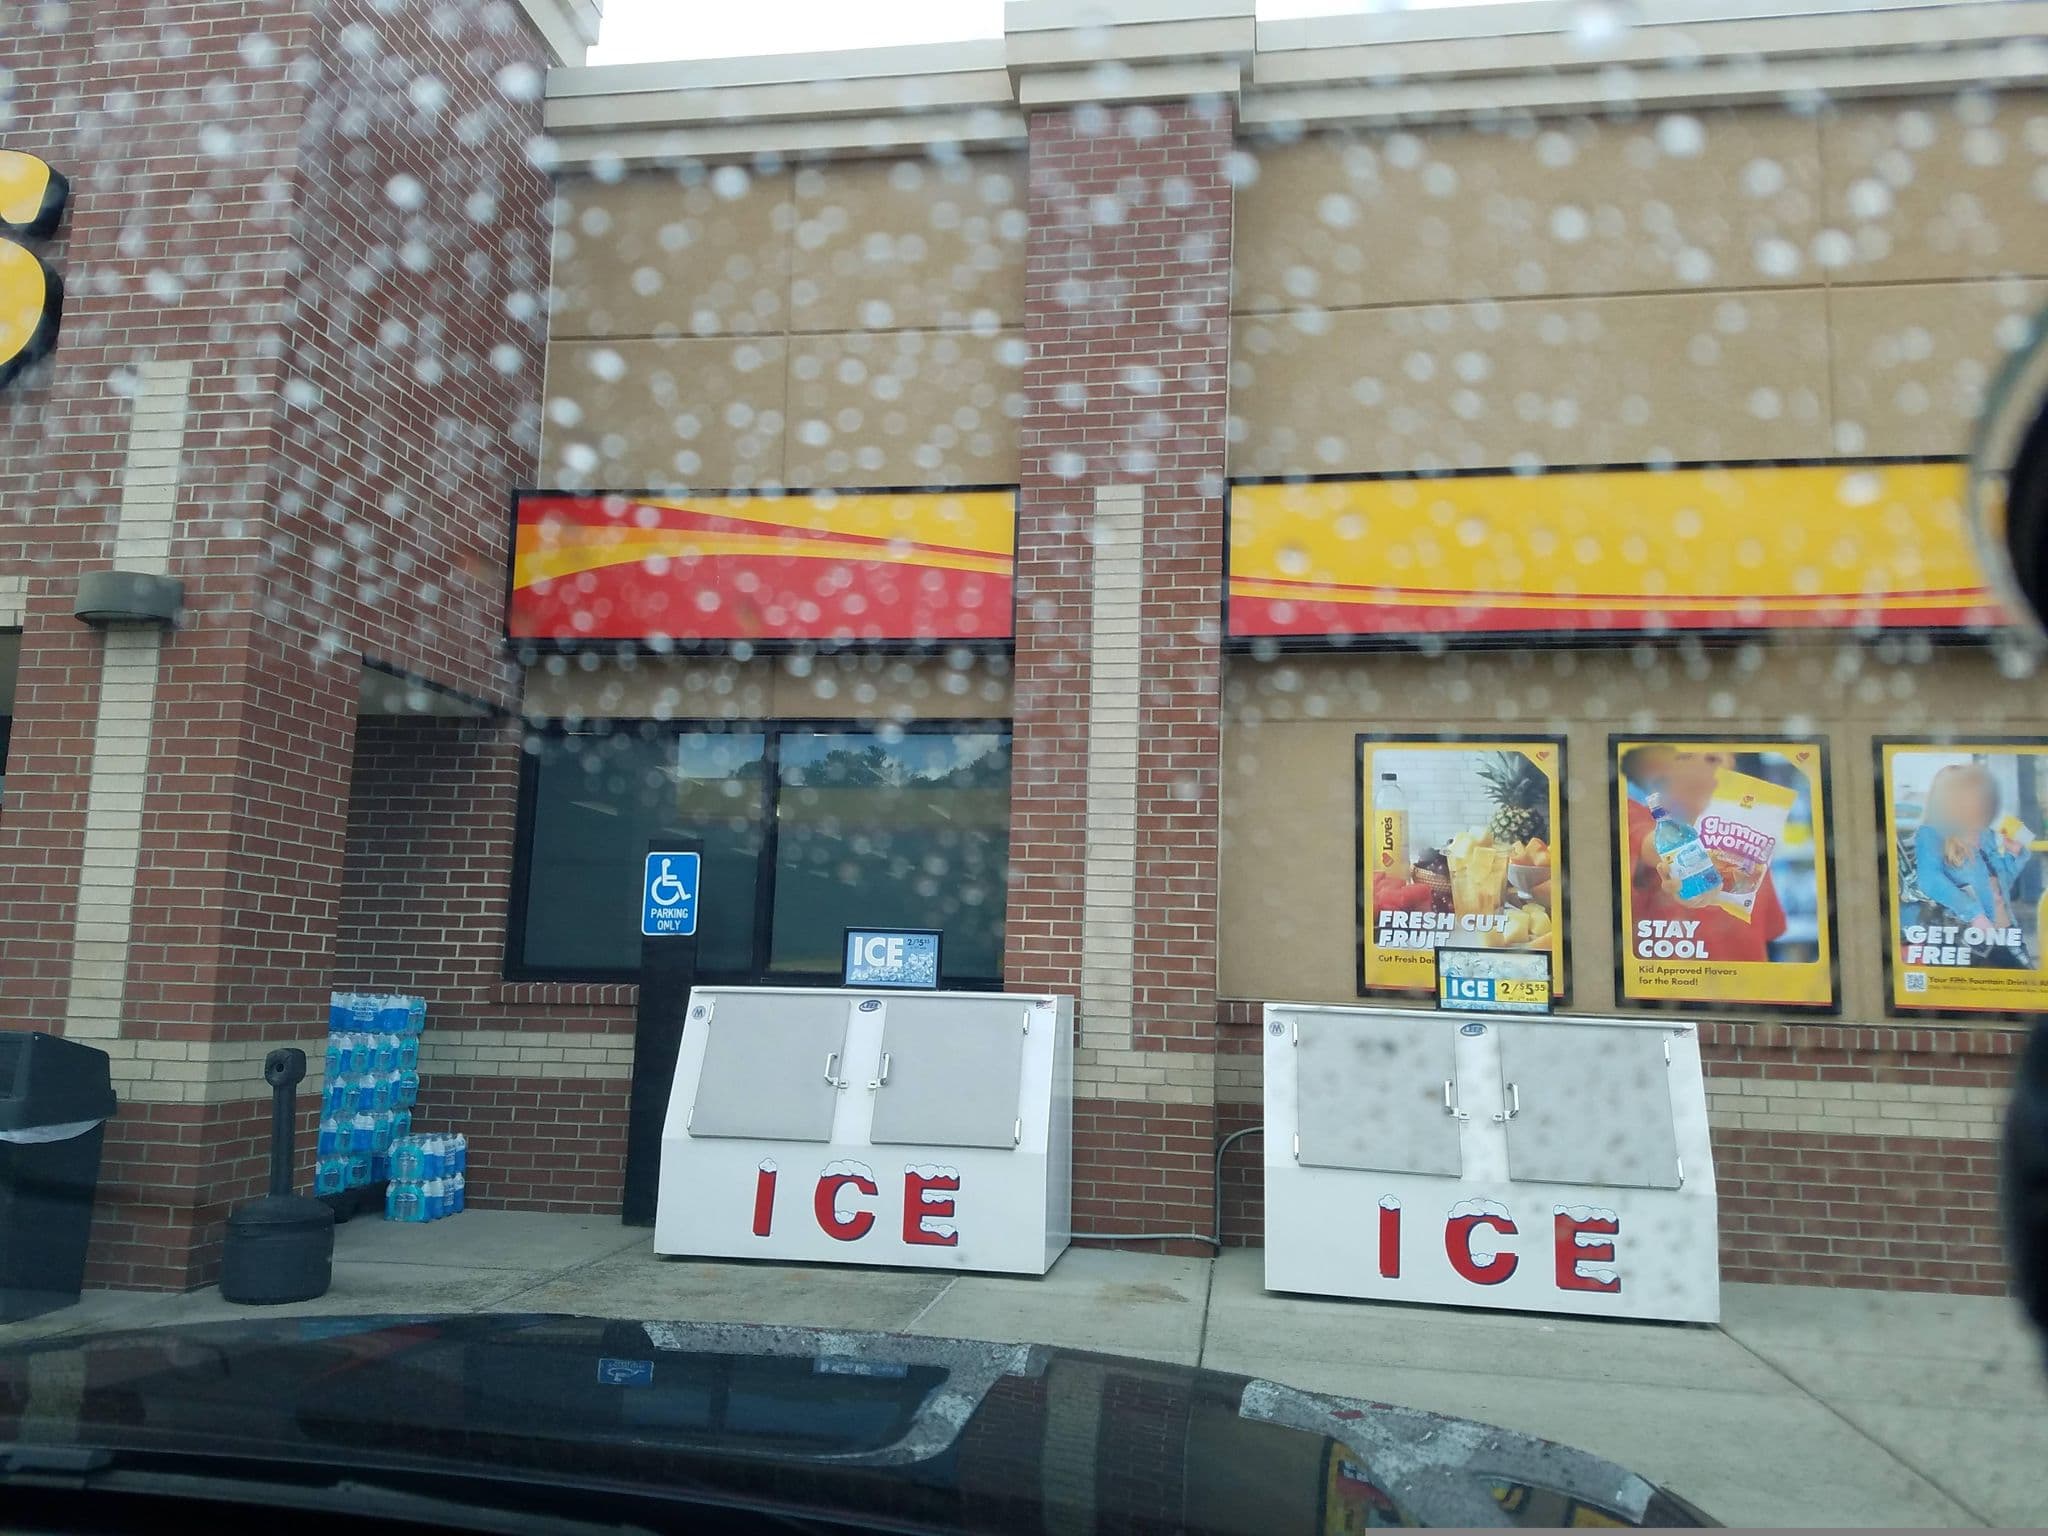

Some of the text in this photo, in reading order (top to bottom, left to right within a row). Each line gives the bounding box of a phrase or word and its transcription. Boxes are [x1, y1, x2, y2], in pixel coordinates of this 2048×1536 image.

[1381, 816, 1394, 851] Love's
[1703, 815, 1777, 852] gummi
[1703, 834, 1774, 863] worms
[650, 908, 689, 919] PARKING
[1378, 910, 1508, 934] FRESH CUT
[657, 919, 681, 931] ONLY
[1637, 919, 1701, 939] STAY
[1378, 928, 1450, 949] FRUIT
[1906, 925, 2022, 947] GET ONE
[853, 936, 904, 967] ICE
[1378, 954, 1435, 965] Cut Fresh Dai
[1638, 939, 1709, 959] COOL
[1906, 945, 1972, 966] FREE
[1638, 965, 1738, 976] Kid Approved Flavors
[1451, 979, 1490, 998] ICE
[1639, 977, 1698, 986] for the Road!
[752, 1157, 962, 1247] ICE
[1377, 1193, 1623, 1294] ICE
